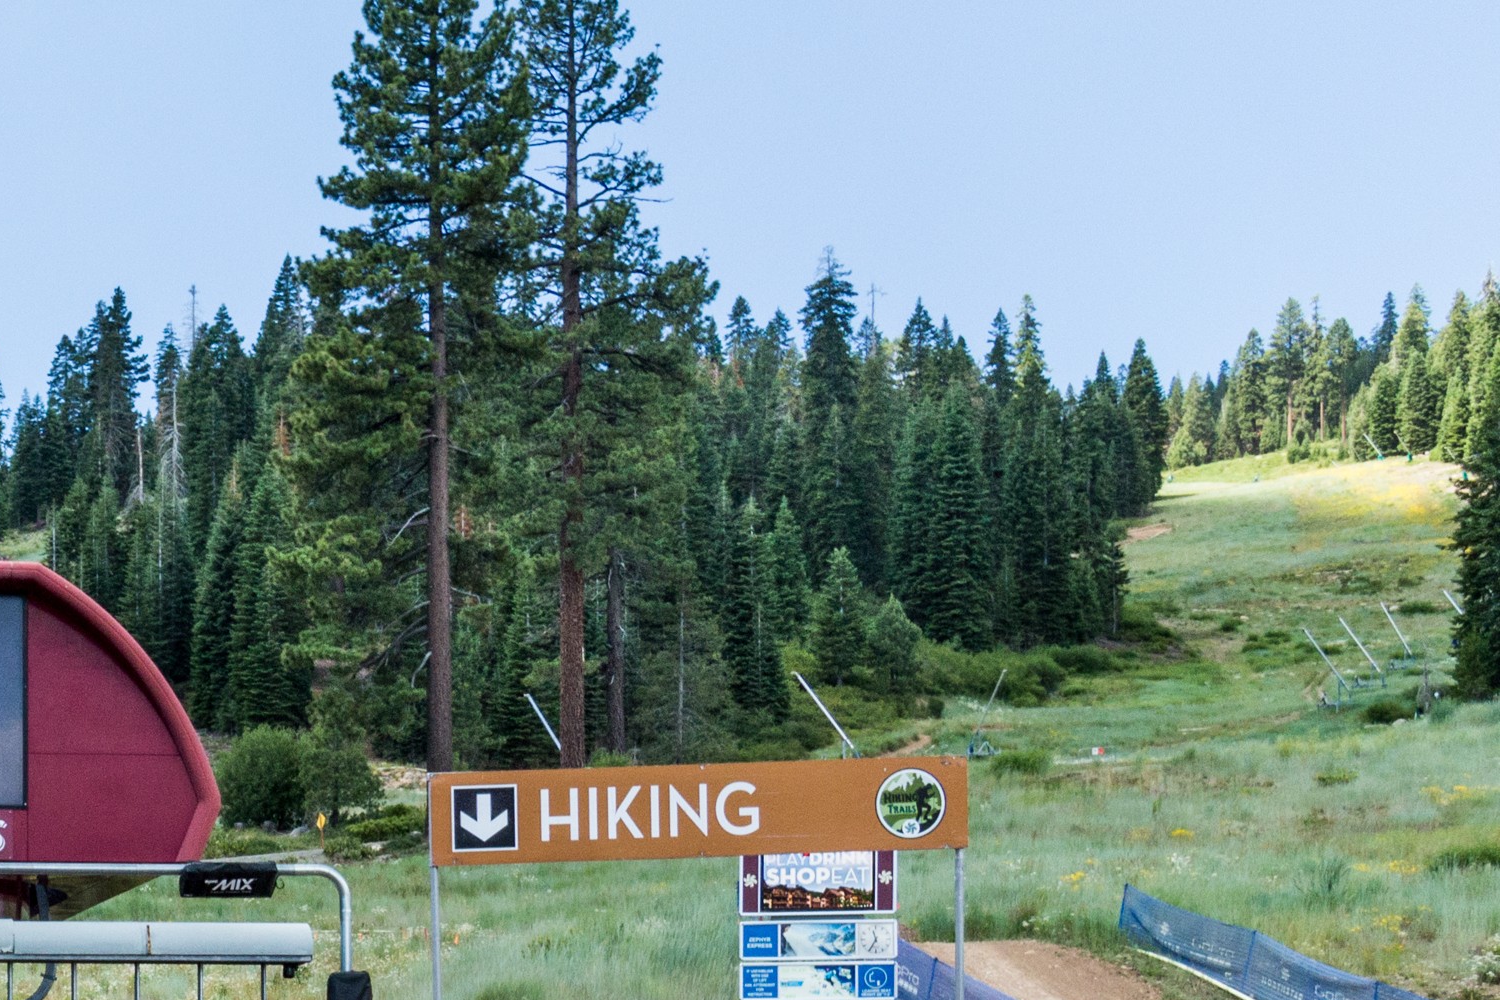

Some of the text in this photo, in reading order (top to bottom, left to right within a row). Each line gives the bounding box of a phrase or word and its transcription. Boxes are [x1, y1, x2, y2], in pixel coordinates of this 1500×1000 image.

[884, 792, 918, 804] HIKING
[540, 780, 760, 842] HIKING
[888, 804, 916, 814] TRAILS
